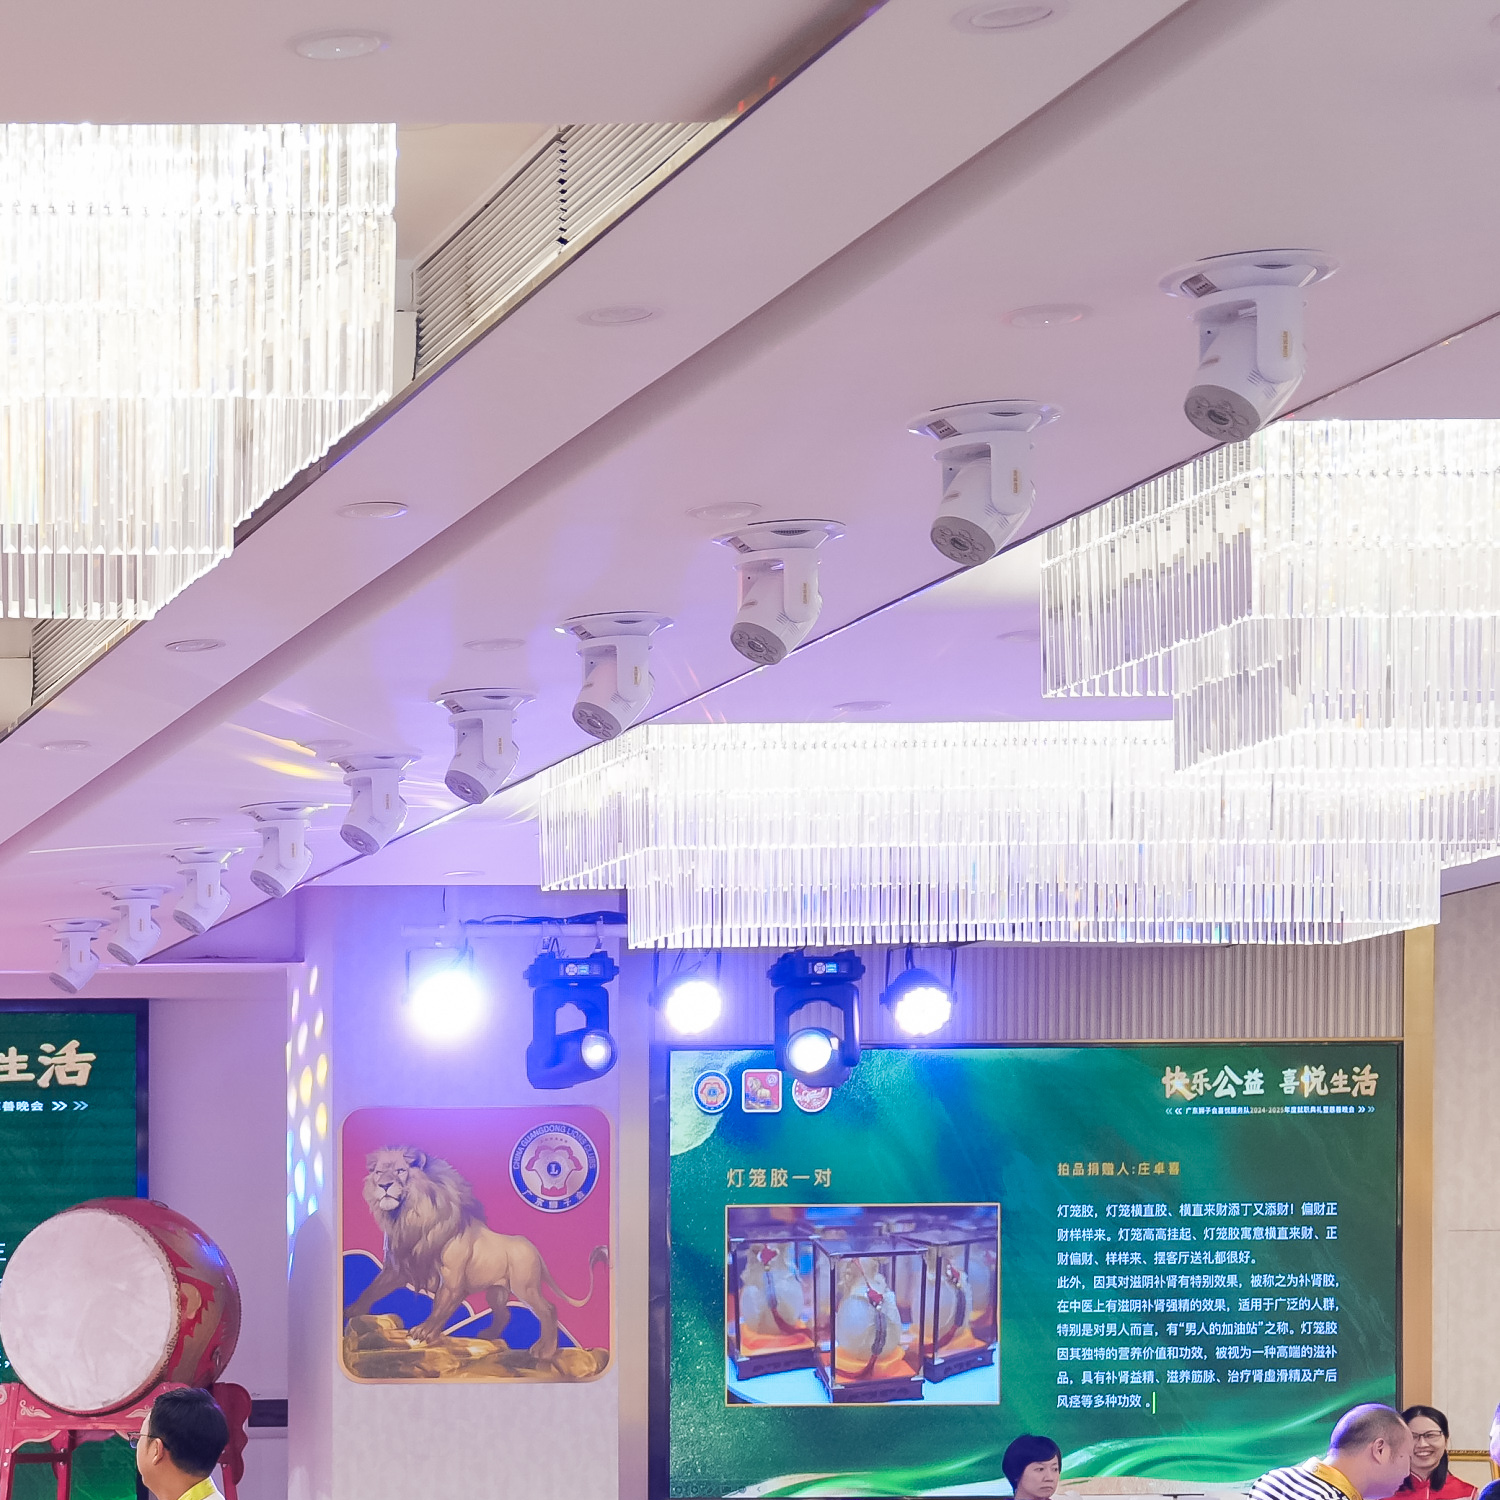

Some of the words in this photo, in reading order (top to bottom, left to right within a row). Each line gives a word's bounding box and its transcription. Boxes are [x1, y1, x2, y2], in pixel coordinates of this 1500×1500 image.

[1161, 1064, 1265, 1101] 快乐公益
[1279, 1063, 1379, 1098] 喜悦生活
[512, 1145, 526, 1170] CHINA
[520, 1124, 567, 1149] GUANGDONG
[566, 1126, 589, 1148] LIONS
[585, 1144, 597, 1170] CLUBS
[549, 1164, 559, 1175] L
[726, 1168, 832, 1188] 灯笼胶一对
